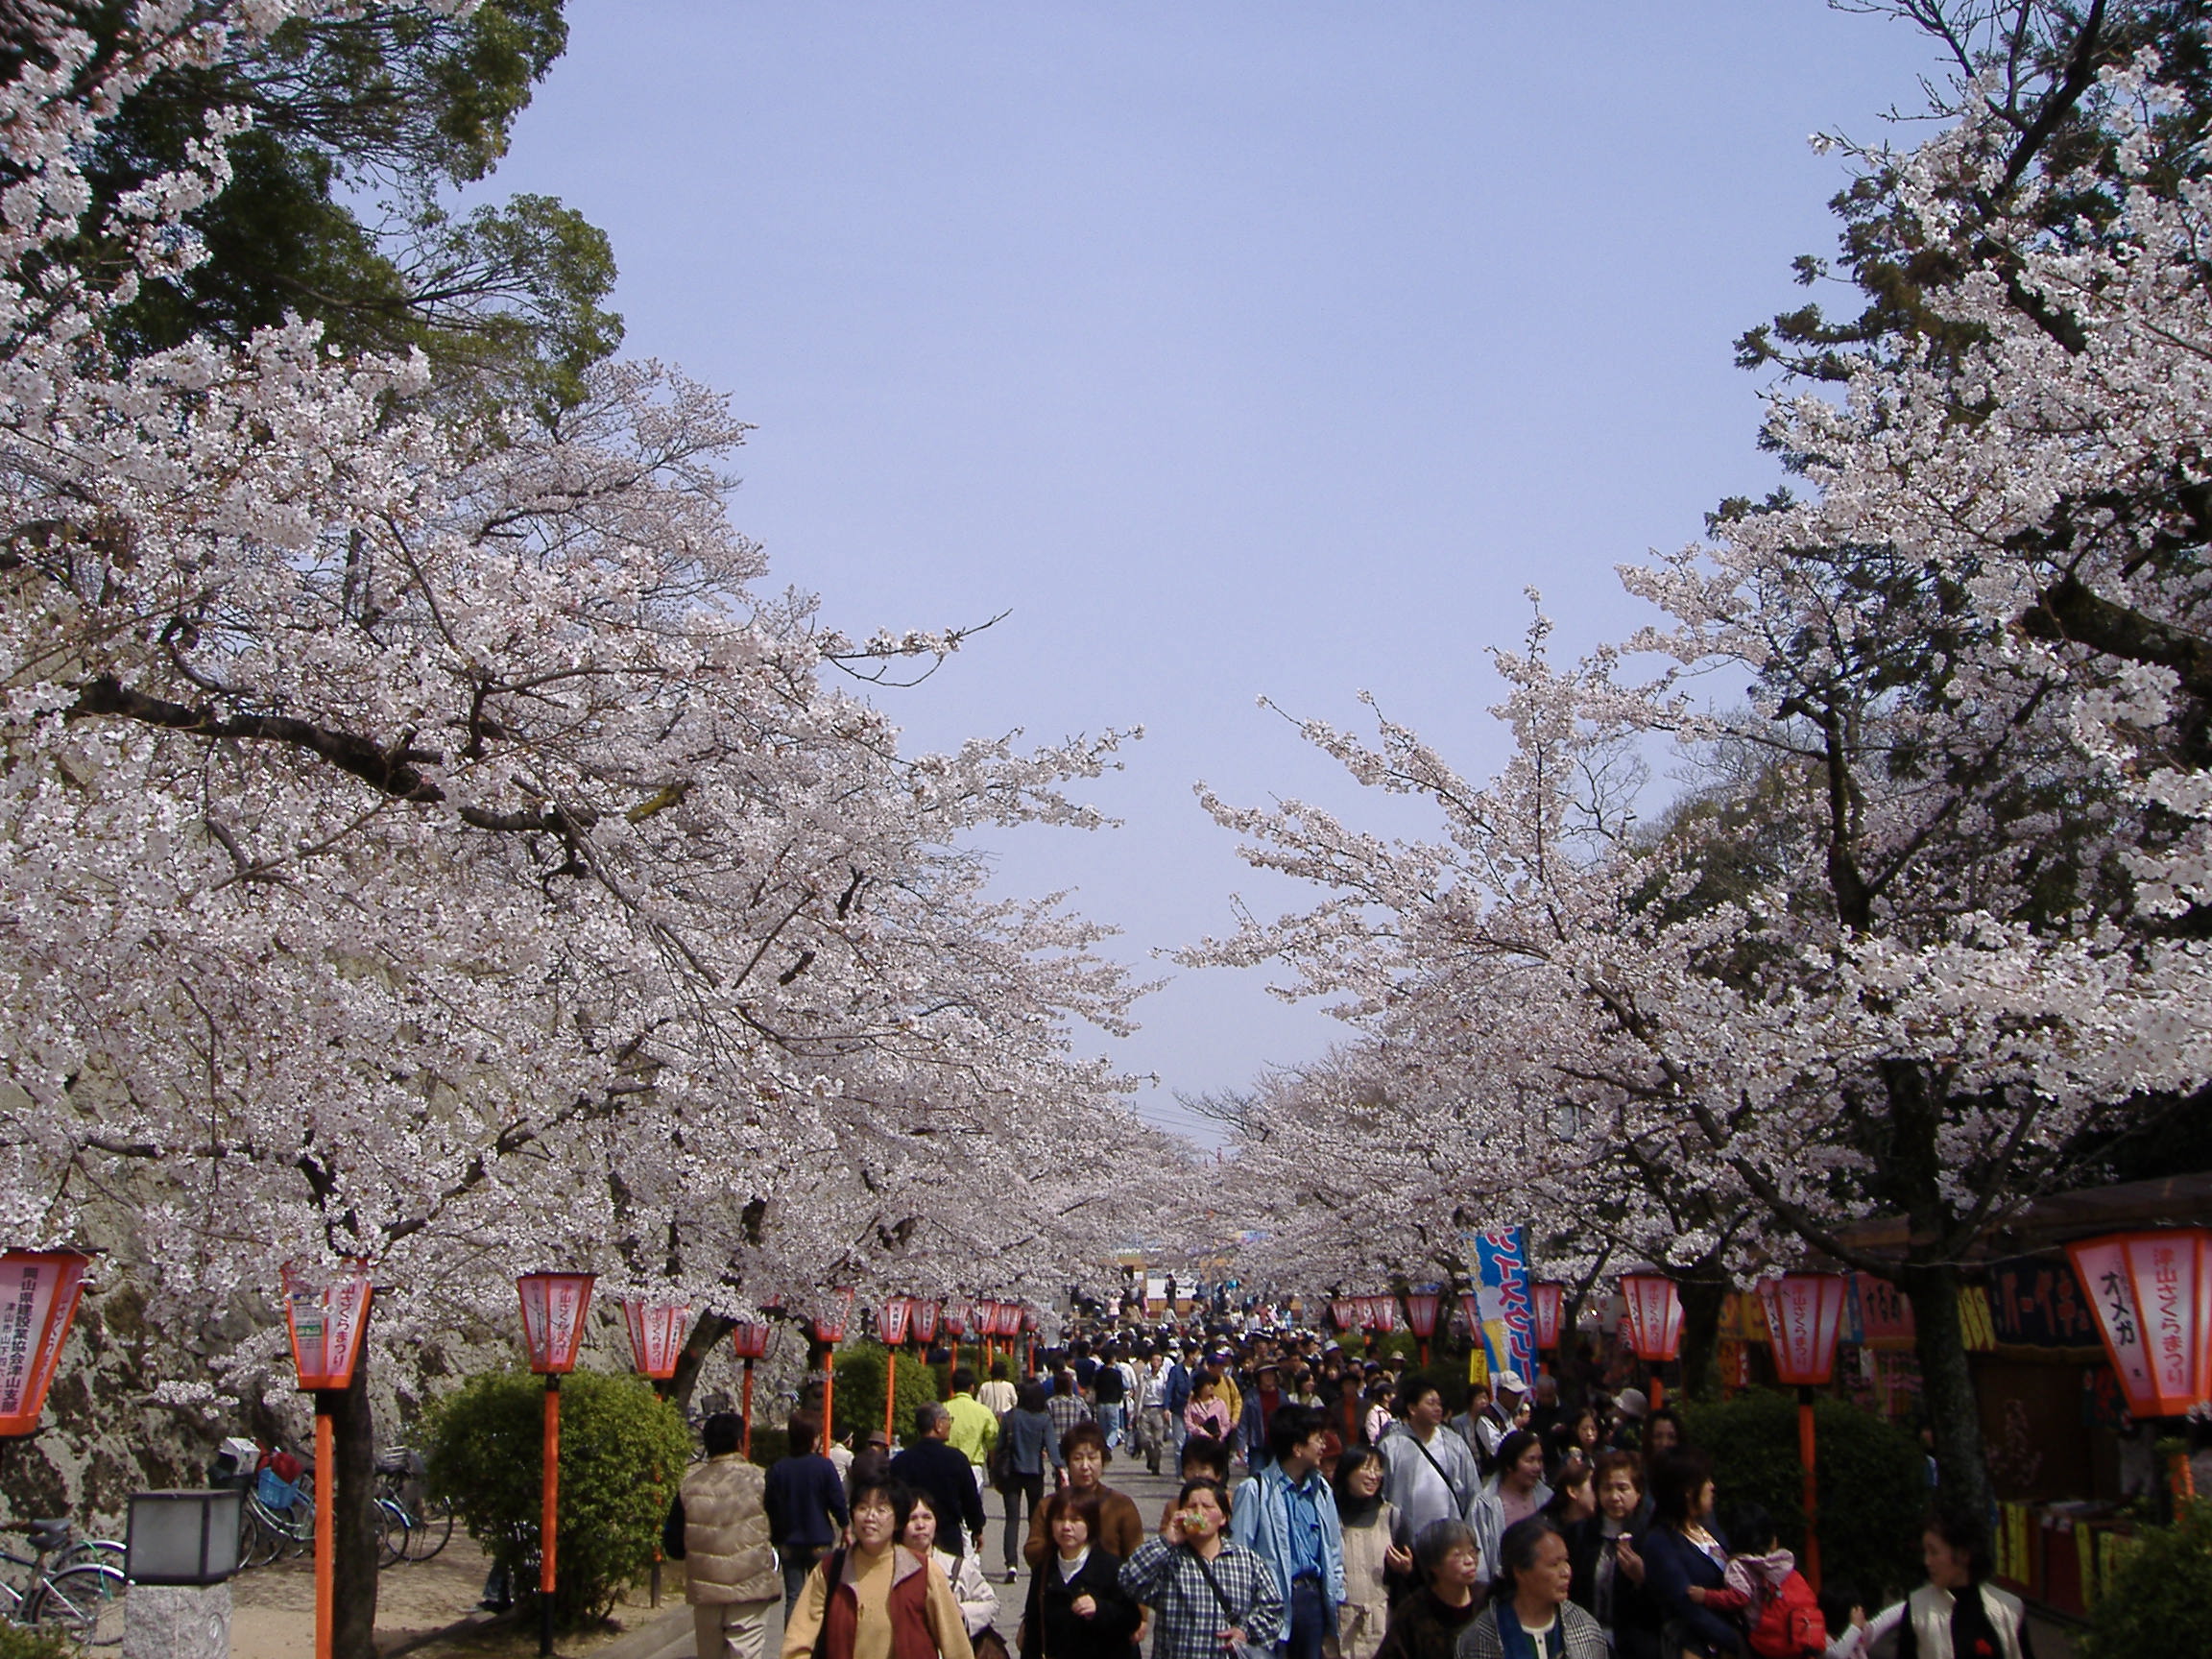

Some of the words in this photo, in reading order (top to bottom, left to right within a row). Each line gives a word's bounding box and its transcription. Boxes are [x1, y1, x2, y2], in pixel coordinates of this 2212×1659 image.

[332, 1284, 356, 1367] 山さくらまつり
[2100, 1270, 2135, 1346] オメガ
[2154, 1248, 2187, 1385] 津山さくらまつり
